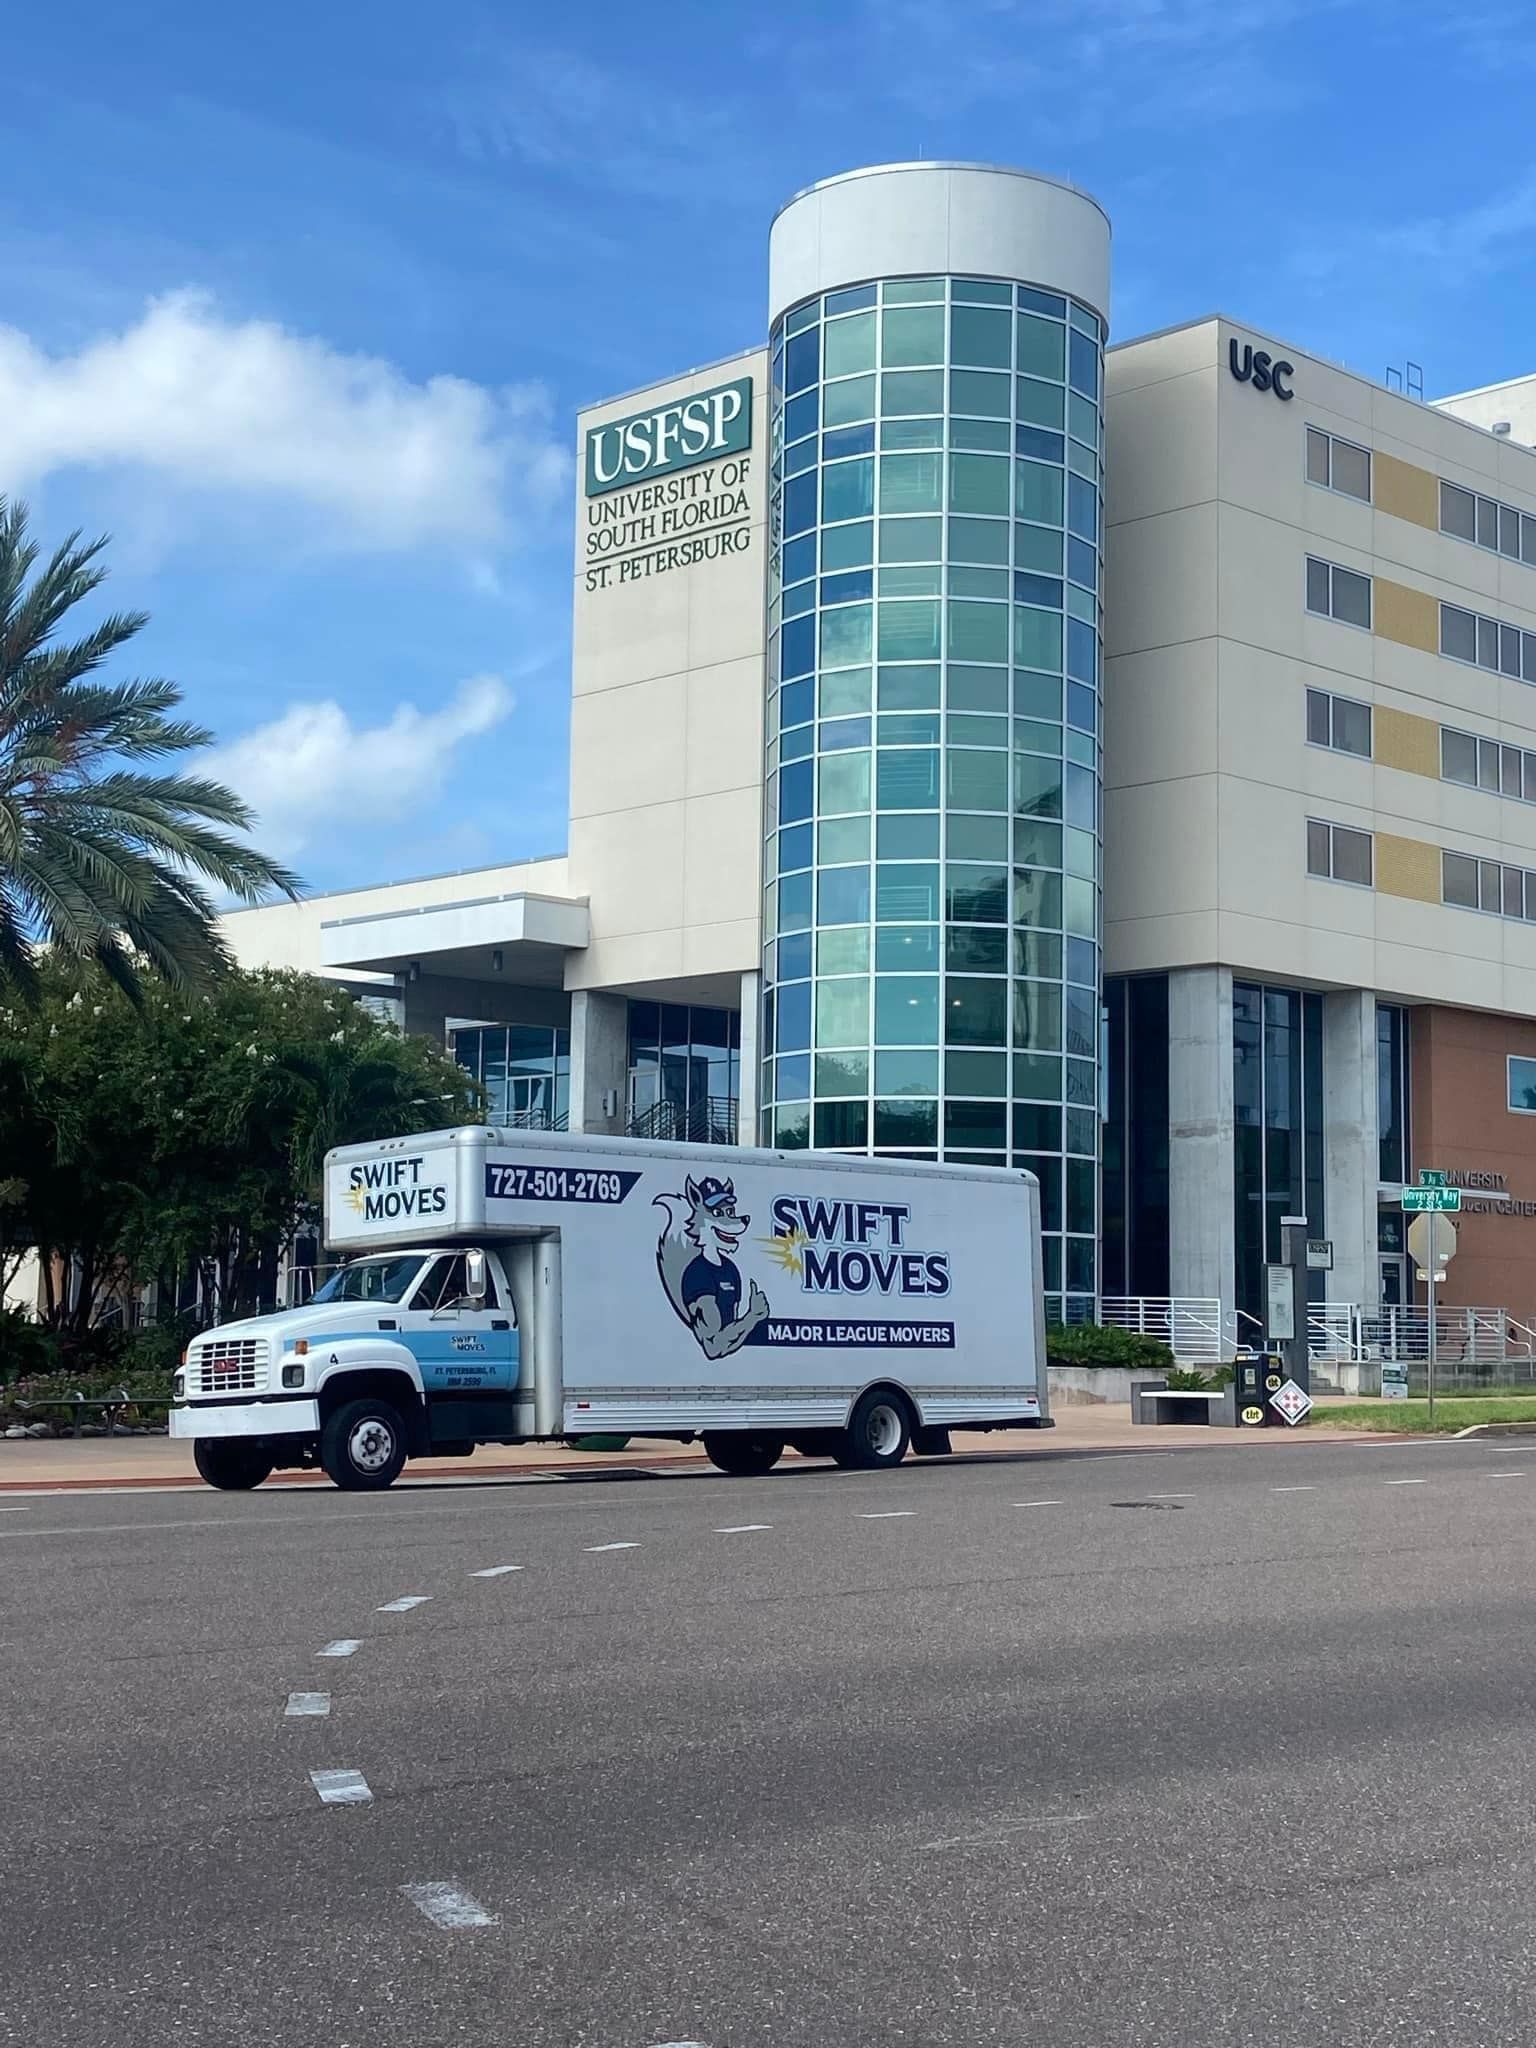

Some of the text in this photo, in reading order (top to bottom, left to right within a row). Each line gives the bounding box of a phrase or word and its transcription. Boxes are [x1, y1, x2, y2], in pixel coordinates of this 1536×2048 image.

[1229, 338, 1295, 401] USC
[591, 389, 742, 483] USFSP
[588, 458, 750, 527] UNIVERSITY OF
[586, 488, 751, 556] SOUTH FLORIDA
[585, 527, 751, 592] ST. PETERSBURG
[350, 1157, 424, 1190] SWIFT
[491, 1167, 622, 1200] 727-501-2769
[1445, 1169, 1508, 1188] UNIVERSITY
[364, 1187, 447, 1221] MOVES
[1404, 1189, 1458, 1204] University Way
[772, 1198, 909, 1246] SWIFT
[802, 1249, 950, 1294] MOVES
[451, 1335, 477, 1344] SWIFT
[457, 1343, 485, 1351] MOVES
[767, 1324, 951, 1342] MAJOR LEAGUE MOVERS
[330, 1353, 339, 1365] 4
